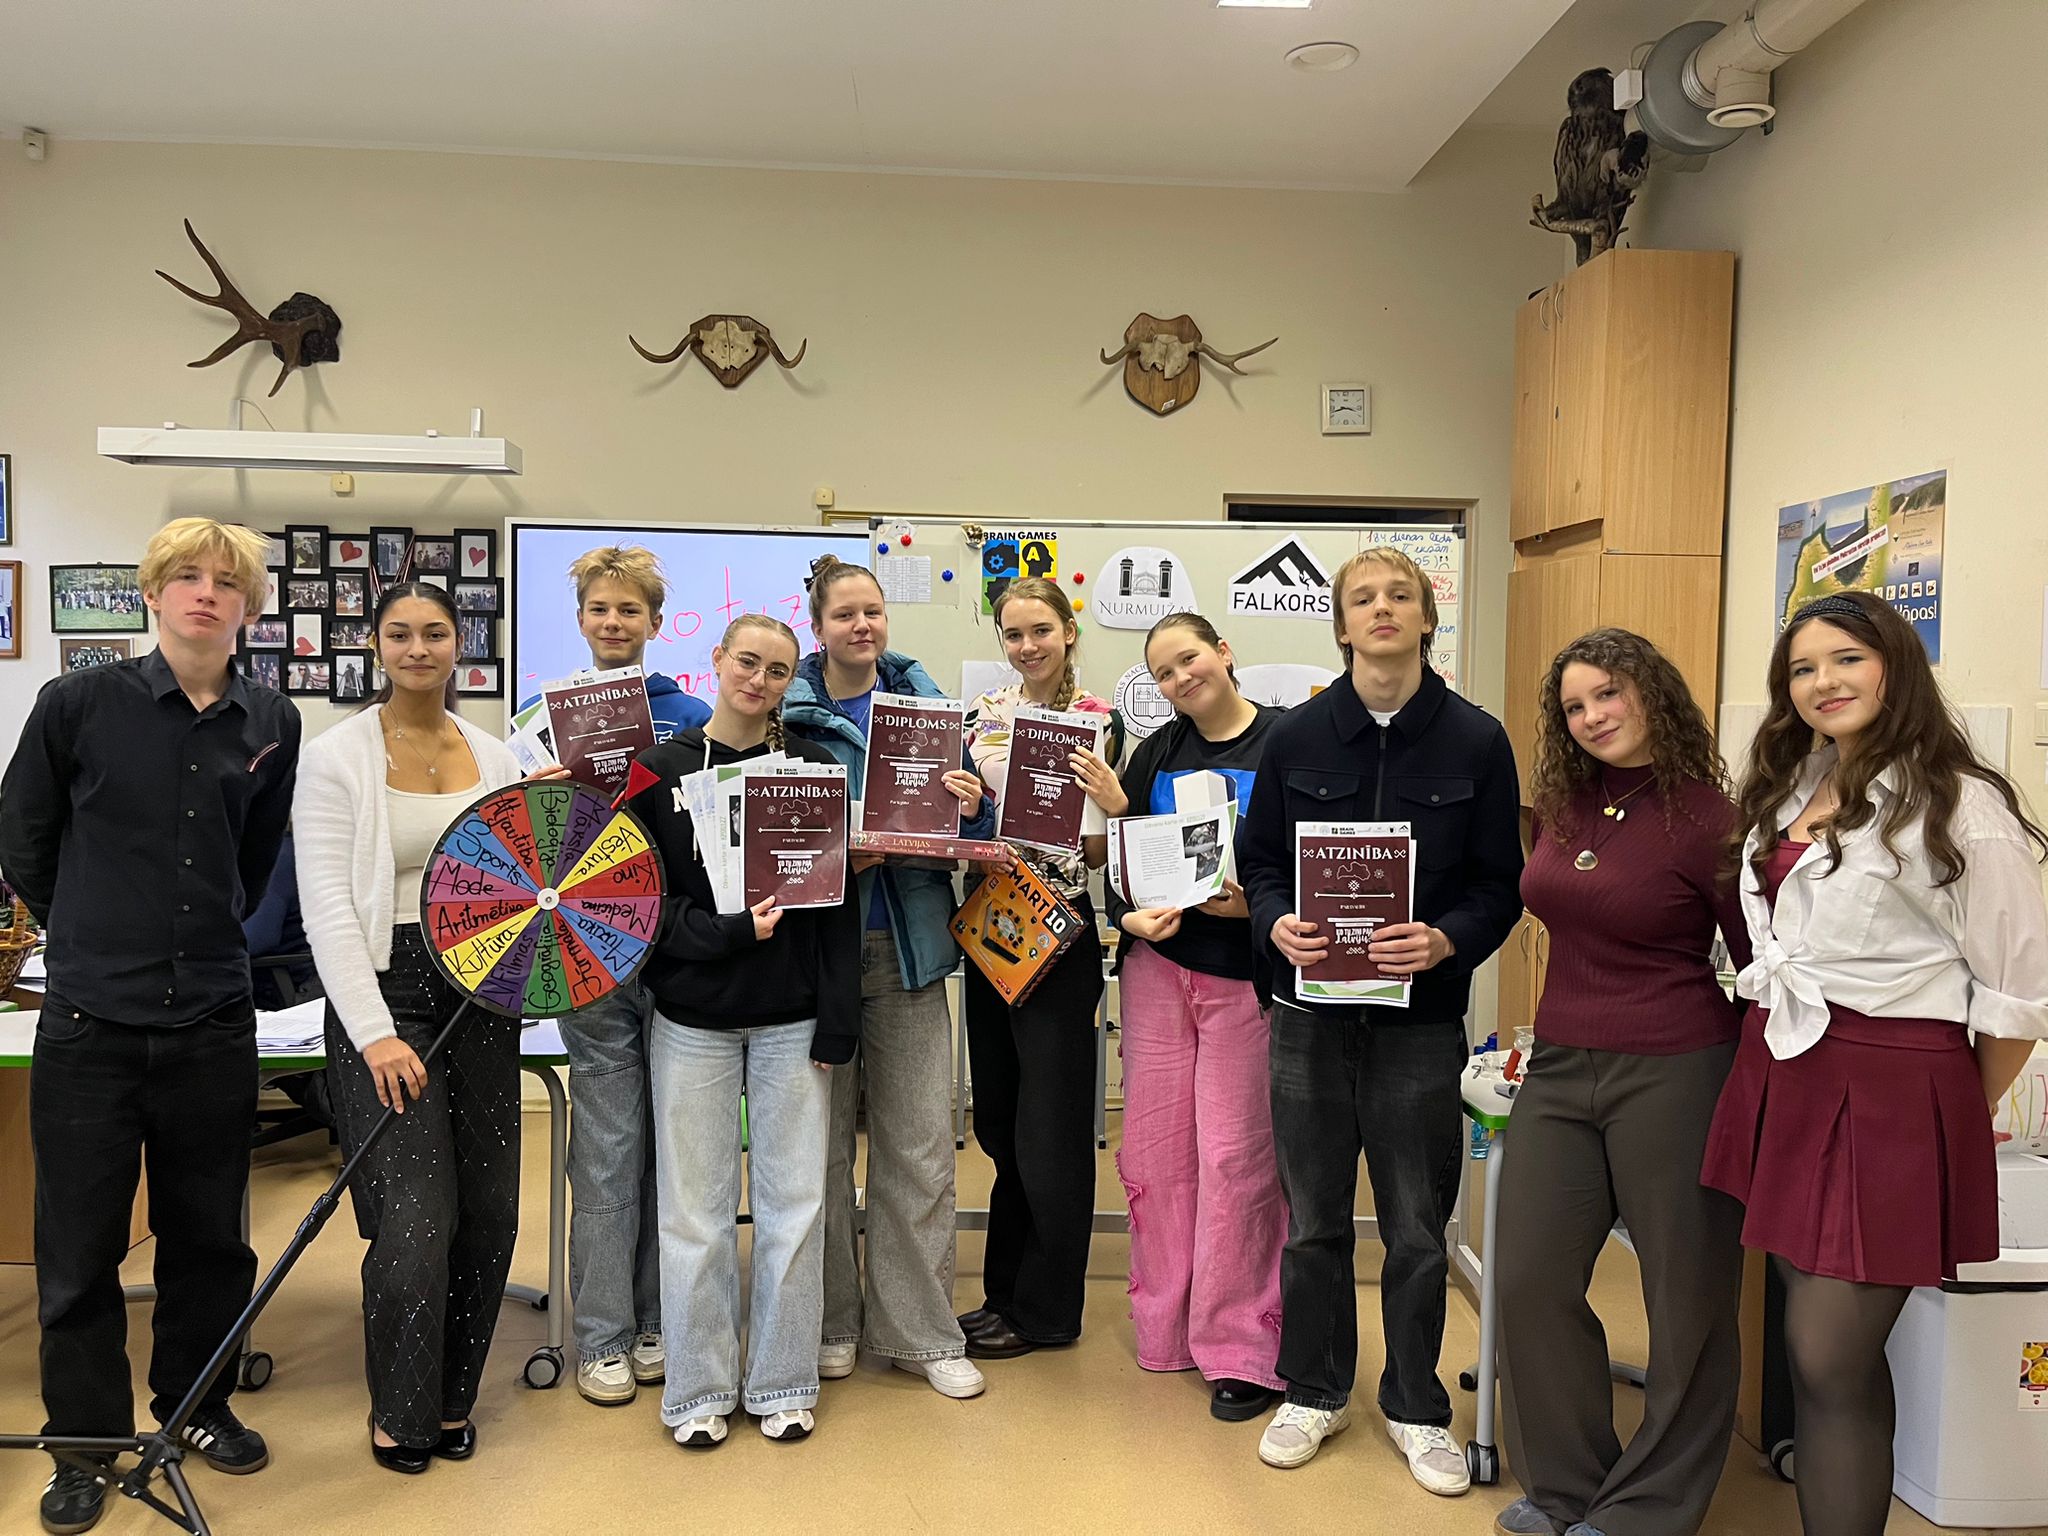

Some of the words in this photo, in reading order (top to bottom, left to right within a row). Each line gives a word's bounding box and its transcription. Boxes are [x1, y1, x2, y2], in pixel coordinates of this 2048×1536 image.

[983, 532, 1016, 540] BRAIN
[1017, 531, 1057, 540] GAMES
[1098, 599, 1194, 617] NURMUIŽAS
[1233, 591, 1330, 613] FALKORS
[563, 687, 632, 709] ATZINĪBA
[884, 715, 948, 731] DIPLOMS
[1027, 727, 1082, 746] DIPLOMS
[760, 783, 831, 798] ATZINĪBA
[485, 793, 535, 869] Atjautība
[563, 792, 606, 868] Māksla
[893, 837, 931, 849] LATVIJAS
[456, 819, 522, 887] Sports
[574, 826, 643, 876] Vēsture
[1315, 844, 1393, 860] ATZINĪBA
[429, 860, 502, 897] Mode
[613, 855, 657, 893] Kino
[581, 900, 656, 935] Medicīna
[1008, 867, 1050, 914] MART
[1044, 909, 1067, 934] 10
[436, 899, 526, 943] Aritmētika
[445, 929, 519, 985] Kultūra
[490, 935, 533, 986] Filmas
[577, 915, 644, 973] Mūzika
